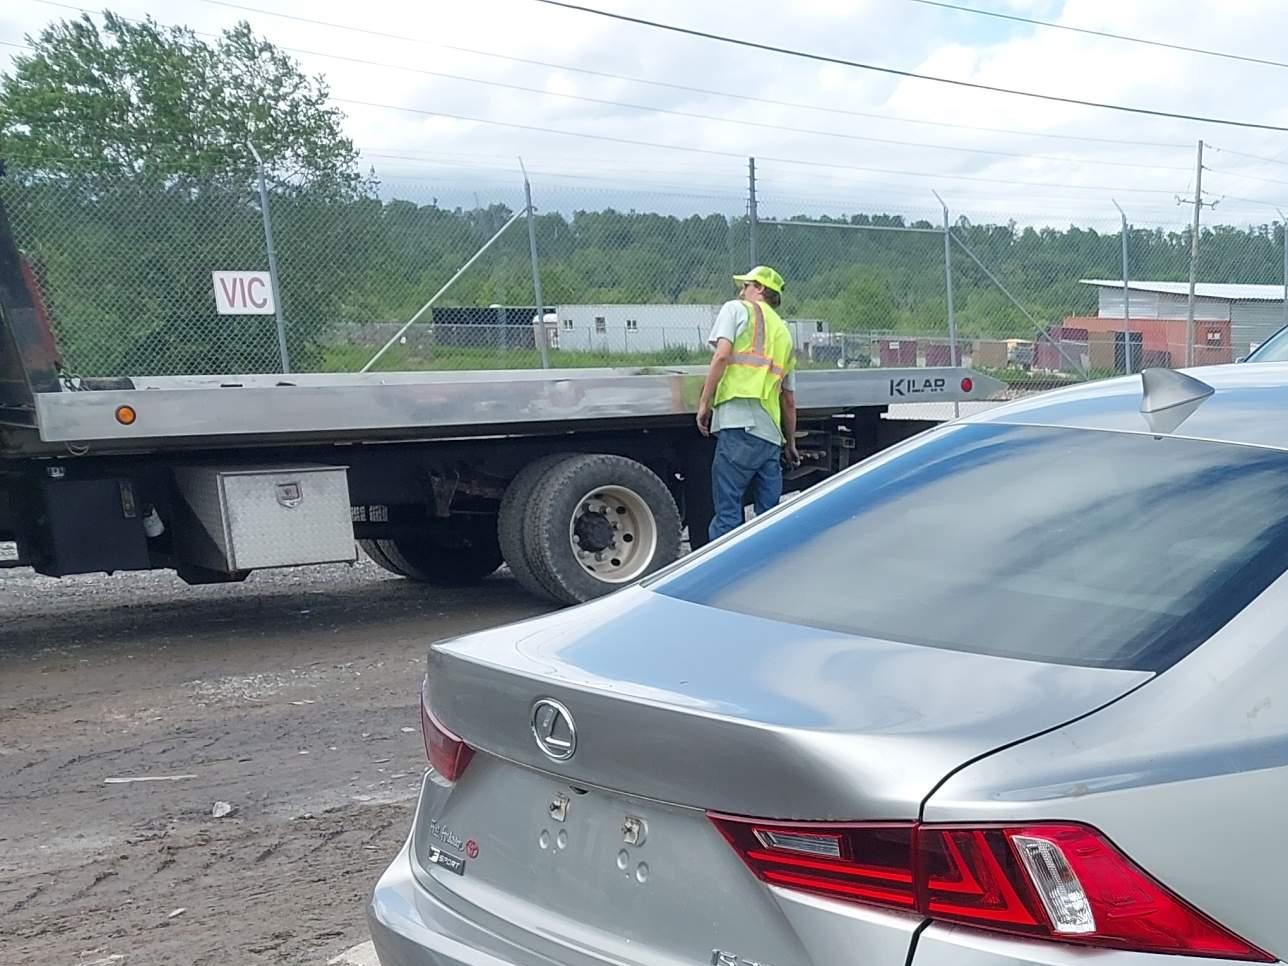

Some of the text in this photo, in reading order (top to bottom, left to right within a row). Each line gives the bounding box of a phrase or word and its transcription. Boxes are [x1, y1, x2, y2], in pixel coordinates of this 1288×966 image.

[219, 276, 268, 309] VIC
[889, 378, 946, 397] KILAR
[438, 854, 461, 871] SPORT
